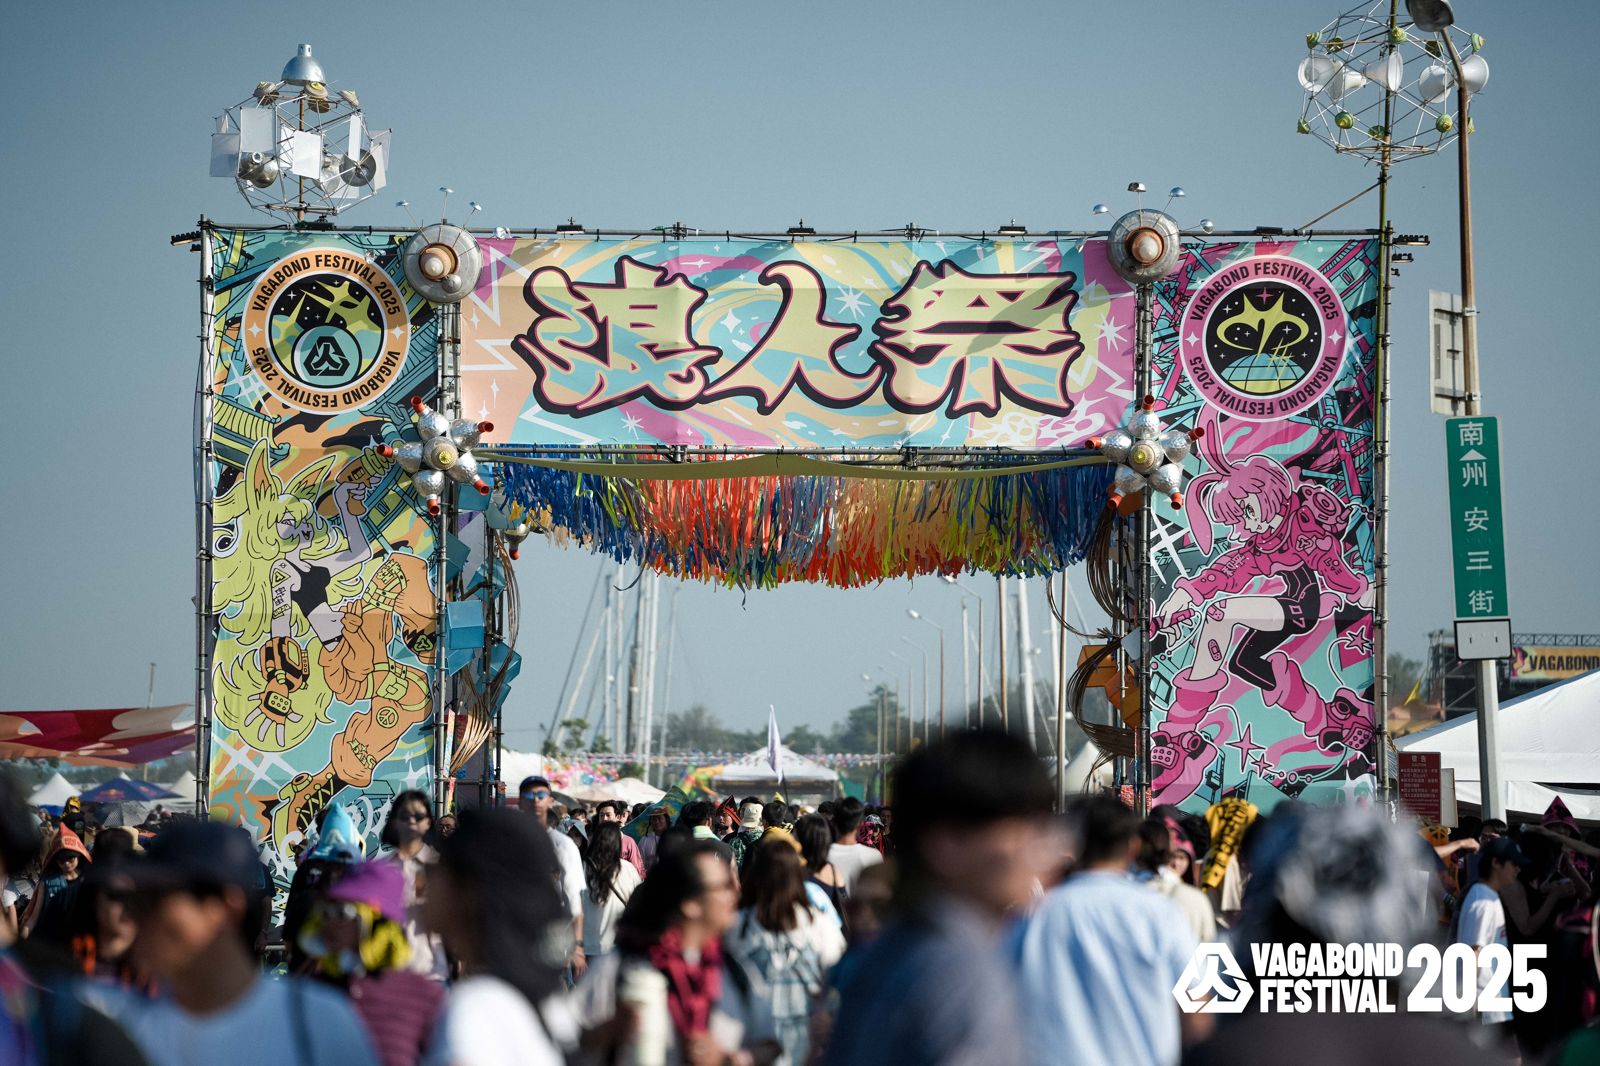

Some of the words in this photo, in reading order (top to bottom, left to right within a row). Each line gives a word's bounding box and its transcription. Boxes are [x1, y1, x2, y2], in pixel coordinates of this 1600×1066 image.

[252, 257, 311, 311] VAGABOND
[315, 254, 377, 285] FESTIVAL
[374, 281, 401, 315] 2025
[1190, 265, 1250, 321] VAGABOND
[1254, 261, 1316, 290] FESTIVAL
[1313, 287, 1339, 320] 2025
[252, 347, 279, 381] 2025
[343, 350, 401, 405] VAGABOND
[1189, 356, 1216, 389] 2025
[276, 378, 338, 408] FESTIVAL
[1213, 386, 1274, 415] FESTIVAL
[1279, 356, 1338, 412] VAGABOND
[1529, 655, 1600, 671] VAGABOND
